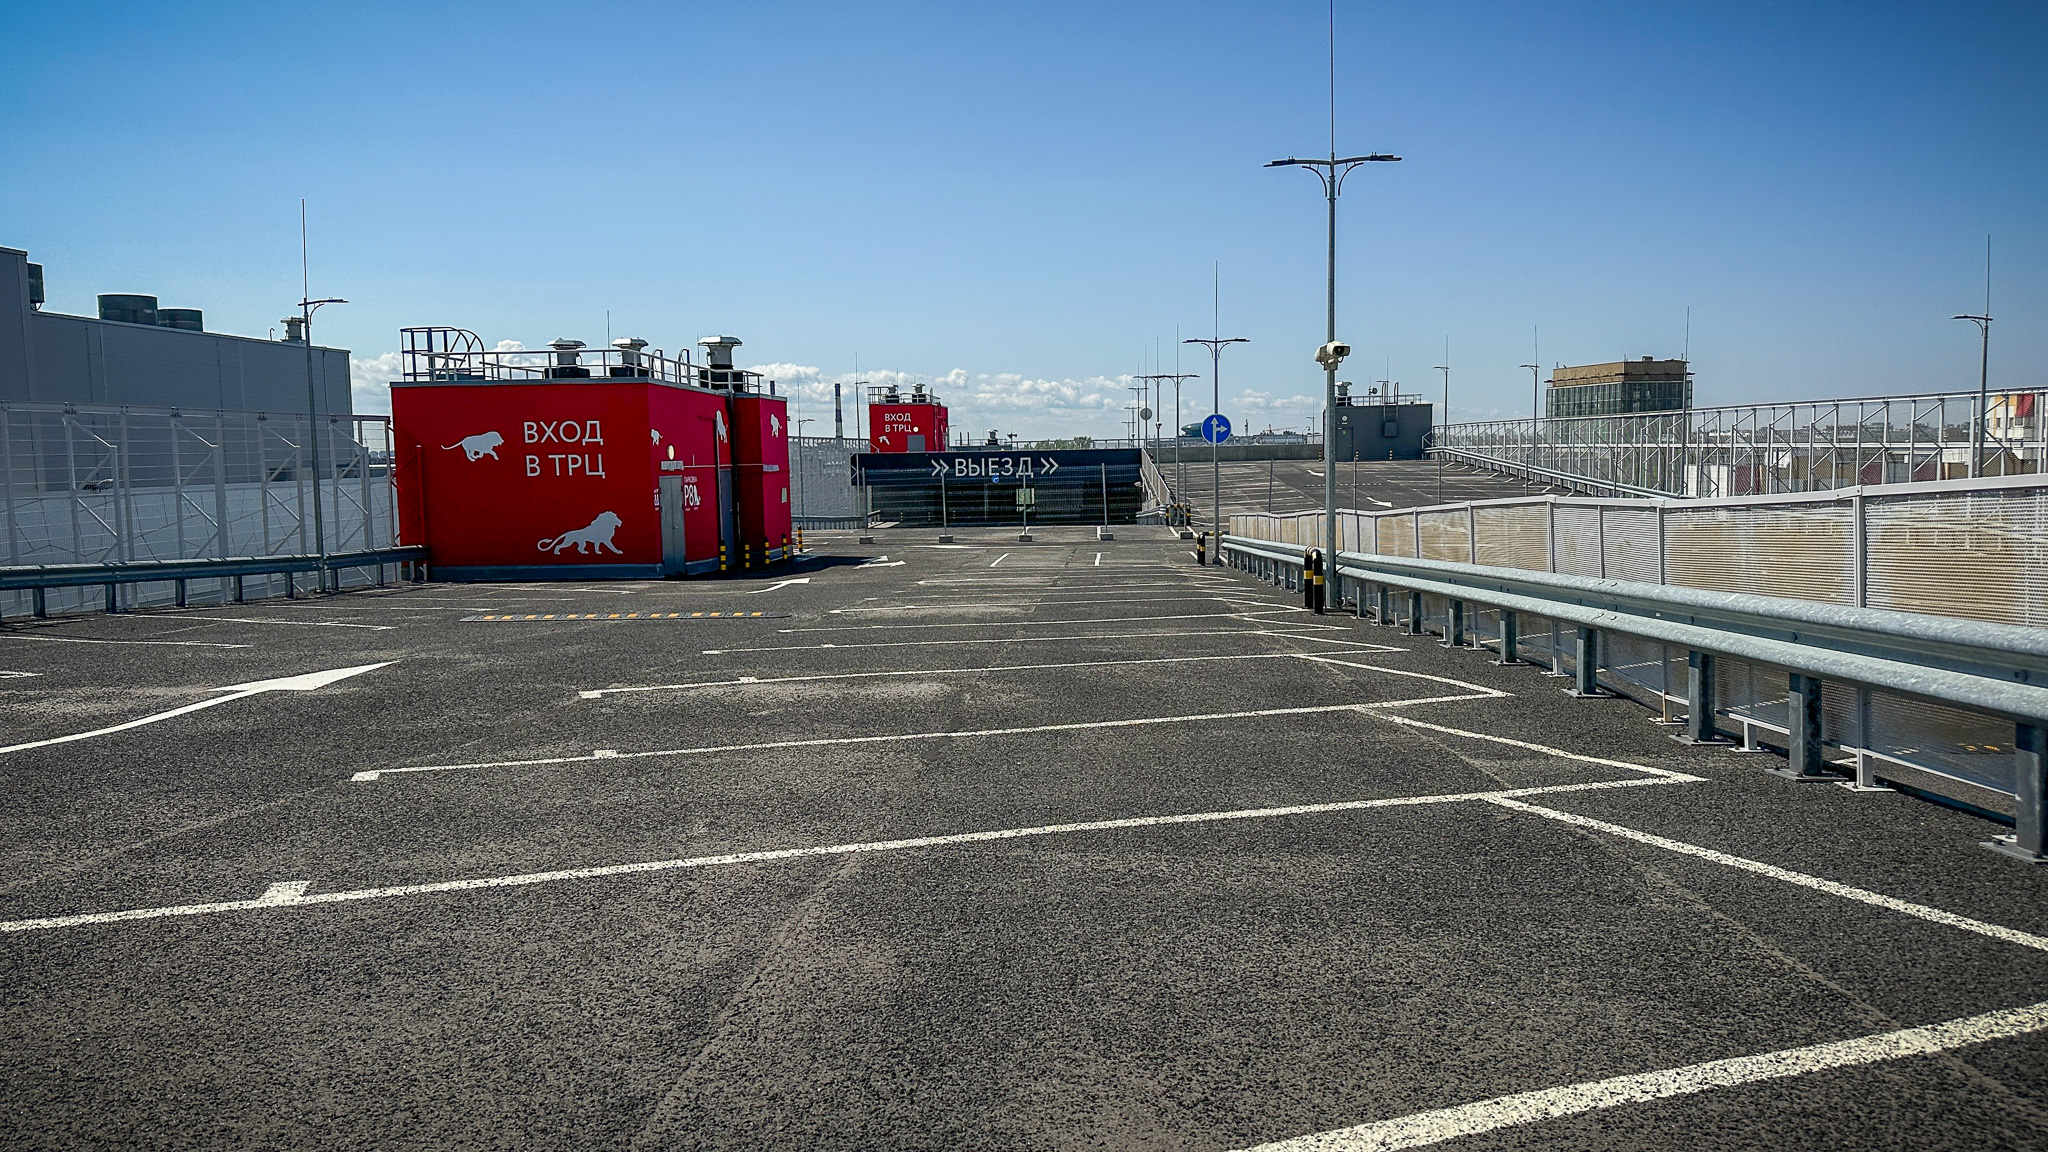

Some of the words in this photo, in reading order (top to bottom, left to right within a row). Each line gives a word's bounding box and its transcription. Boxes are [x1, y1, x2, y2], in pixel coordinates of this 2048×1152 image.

[884, 413, 911, 422] ВХОД
[885, 424, 891, 433] В
[893, 424, 912, 433] ТРЦ
[523, 420, 604, 446] ВХОД
[525, 455, 541, 477] В
[548, 453, 606, 479] ТРЦ
[955, 457, 1034, 479] ВЫЕЗД
